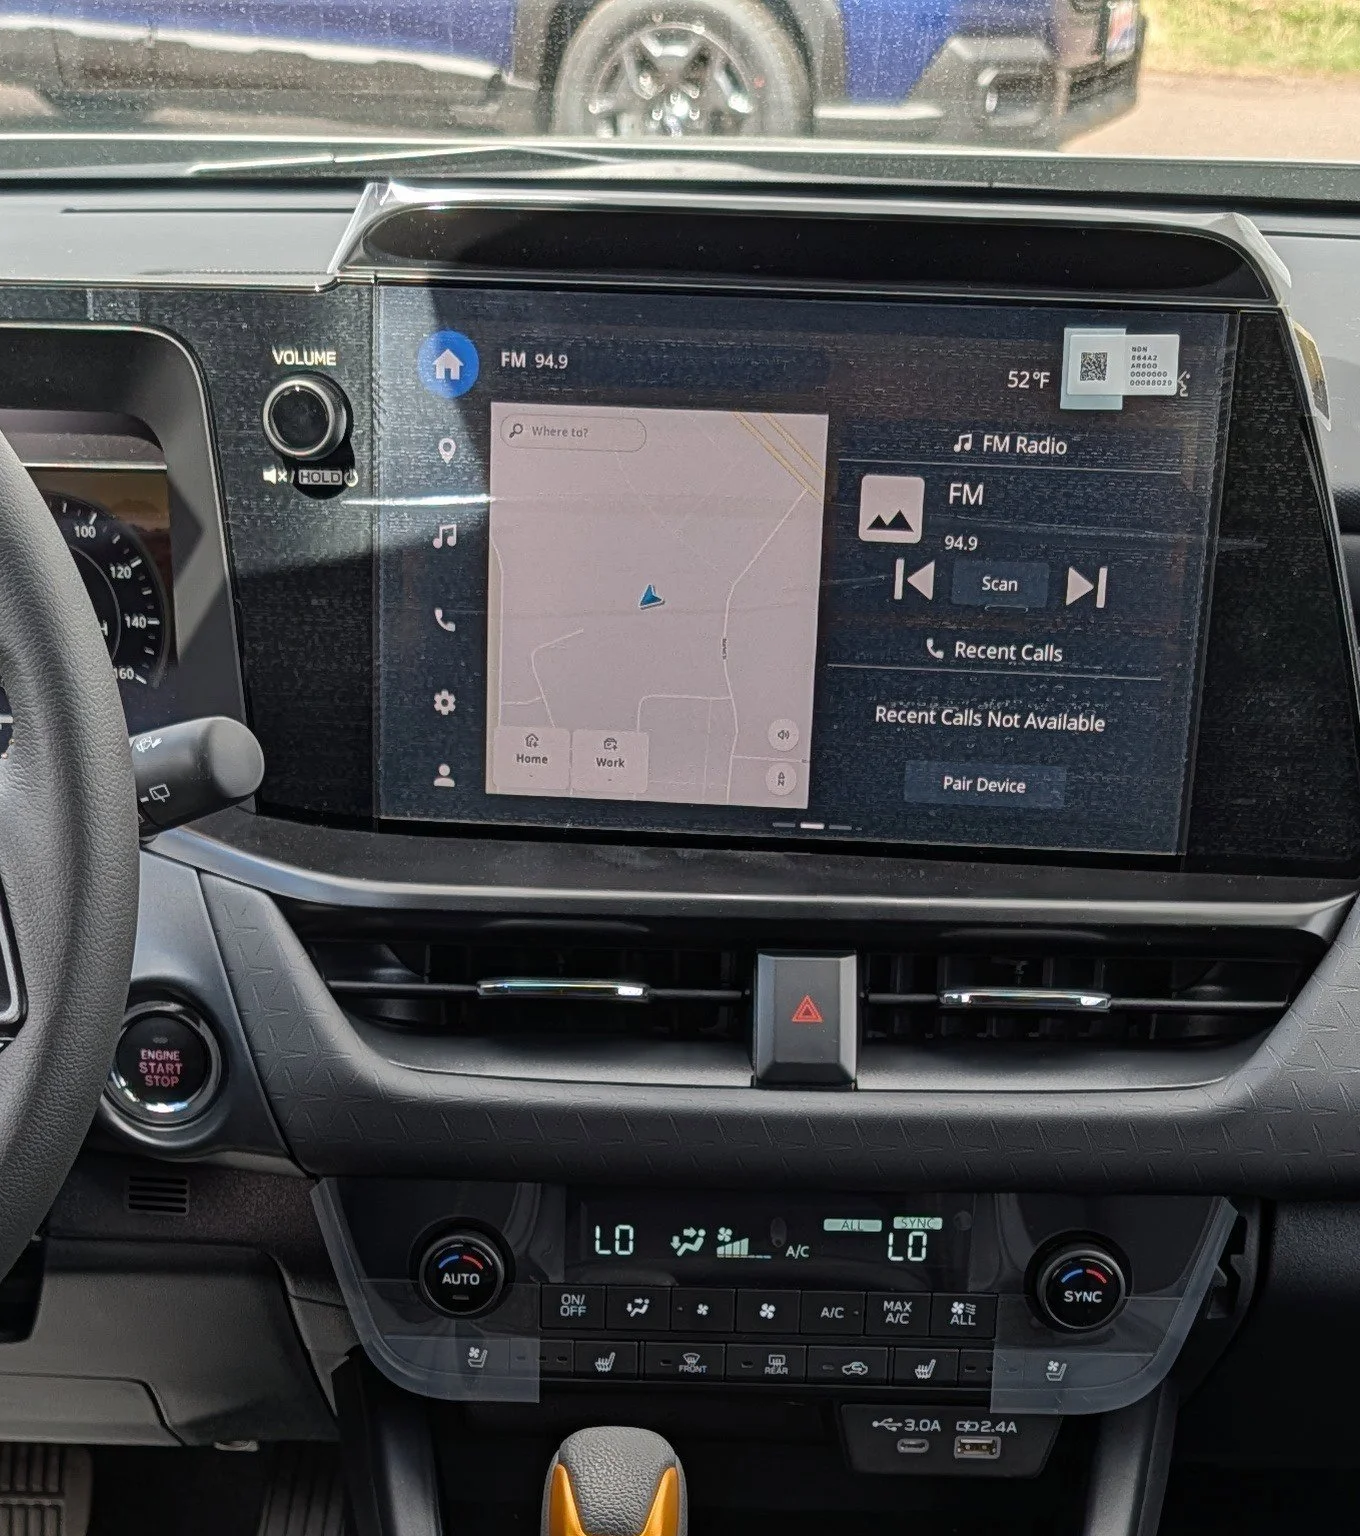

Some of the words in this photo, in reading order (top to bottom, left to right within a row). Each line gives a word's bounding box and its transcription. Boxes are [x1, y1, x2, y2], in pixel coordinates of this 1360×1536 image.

[272, 349, 337, 366] VOLUME
[501, 351, 526, 368] FM
[535, 353, 568, 370] 94.9
[532, 425, 568, 438] Where
[571, 427, 589, 439] to?
[983, 436, 1010, 453] FM
[1016, 437, 1067, 456] Radio
[299, 471, 341, 484] HOLD
[949, 483, 984, 506] FM
[74, 526, 96, 538] 100
[944, 535, 978, 552] 94.9
[110, 566, 132, 579] 120
[982, 576, 1018, 592] Scan
[125, 616, 147, 629] 140
[955, 641, 1017, 661] Recent
[1021, 644, 1063, 663] Calls
[875, 705, 937, 726] Recent
[941, 709, 983, 728] Calls
[987, 711, 1021, 729] Not
[1024, 714, 1106, 733] Available
[516, 753, 548, 765] Home
[596, 756, 625, 769] Work
[943, 776, 974, 792] Pair
[977, 777, 1026, 794] Device
[141, 1048, 180, 1061] ENGINE
[139, 1061, 182, 1075] START
[145, 1074, 179, 1087] STOP
[841, 1220, 864, 1231] ALL
[901, 1217, 936, 1229] SYNC
[595, 1224, 635, 1255] LO
[786, 1245, 810, 1259] A/C
[887, 1231, 928, 1262] LO
[442, 1273, 480, 1286] AUTO
[561, 1294, 586, 1306] ON/
[1064, 1290, 1103, 1303] SYNC
[560, 1305, 586, 1317] OFF
[820, 1307, 844, 1319] A/C
[883, 1301, 912, 1313] MAX
[885, 1312, 910, 1325] A/C
[951, 1314, 976, 1326] ALL
[679, 1364, 707, 1374] FRONT
[764, 1366, 788, 1375] REAR
[904, 1419, 941, 1432] 3.0A
[980, 1420, 1018, 1433] 2.4A
